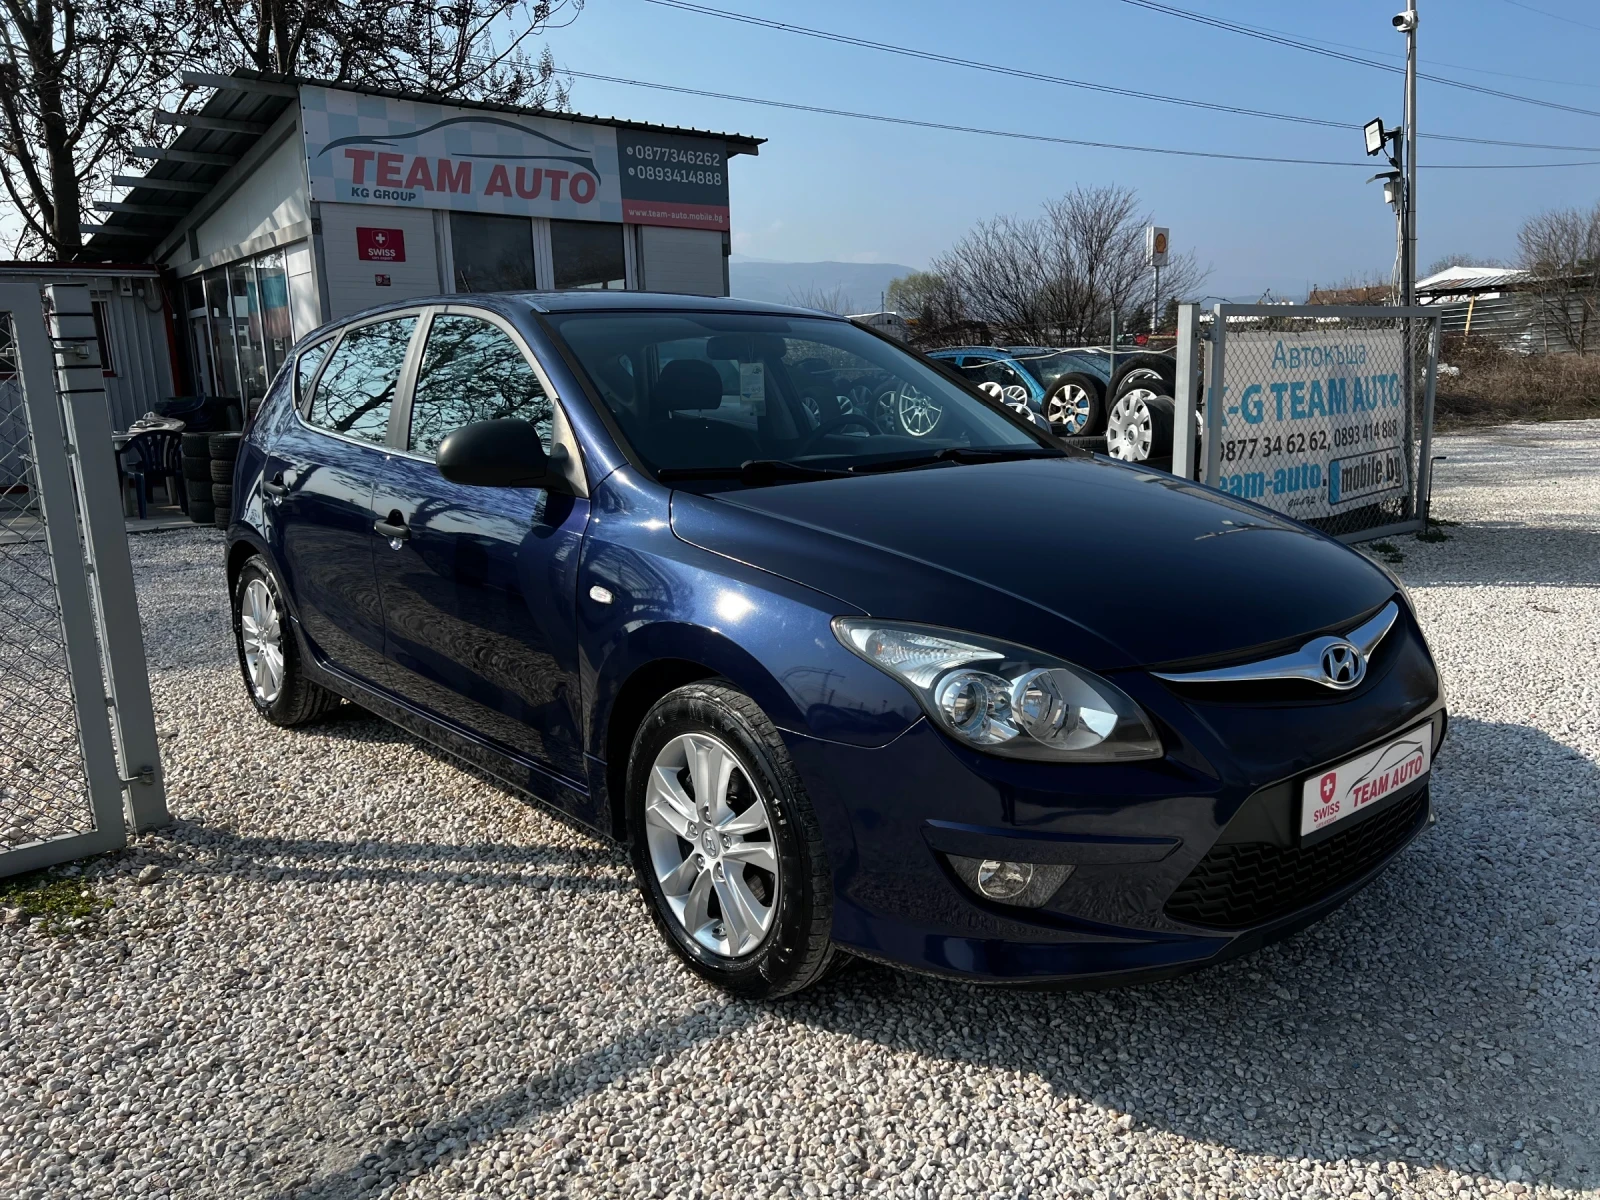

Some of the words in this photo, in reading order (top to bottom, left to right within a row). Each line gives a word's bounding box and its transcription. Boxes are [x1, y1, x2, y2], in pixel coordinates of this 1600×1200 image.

[635, 145, 721, 167] 0877346262
[344, 148, 473, 195] TEAM
[483, 164, 596, 205] AUTO
[637, 165, 722, 186] 0893414888
[351, 186, 370, 198] KG
[373, 188, 417, 202] GROUP
[628, 208, 724, 224] www.team-auto.mobile.bg
[367, 247, 396, 257] SWISS
[1269, 377, 1348, 422] TEAM
[1352, 372, 1400, 413] AUTO
[1262, 436, 1283, 458] 34
[1286, 433, 1306, 454] 62
[1334, 425, 1360, 447] 0893
[1363, 421, 1380, 442] 414
[1382, 418, 1398, 439] 888
[1341, 453, 1402, 493] mobile.bg
[1352, 772, 1390, 808] TEAM
[1390, 755, 1424, 790] AUTO
[1313, 800, 1341, 823] SWISS
